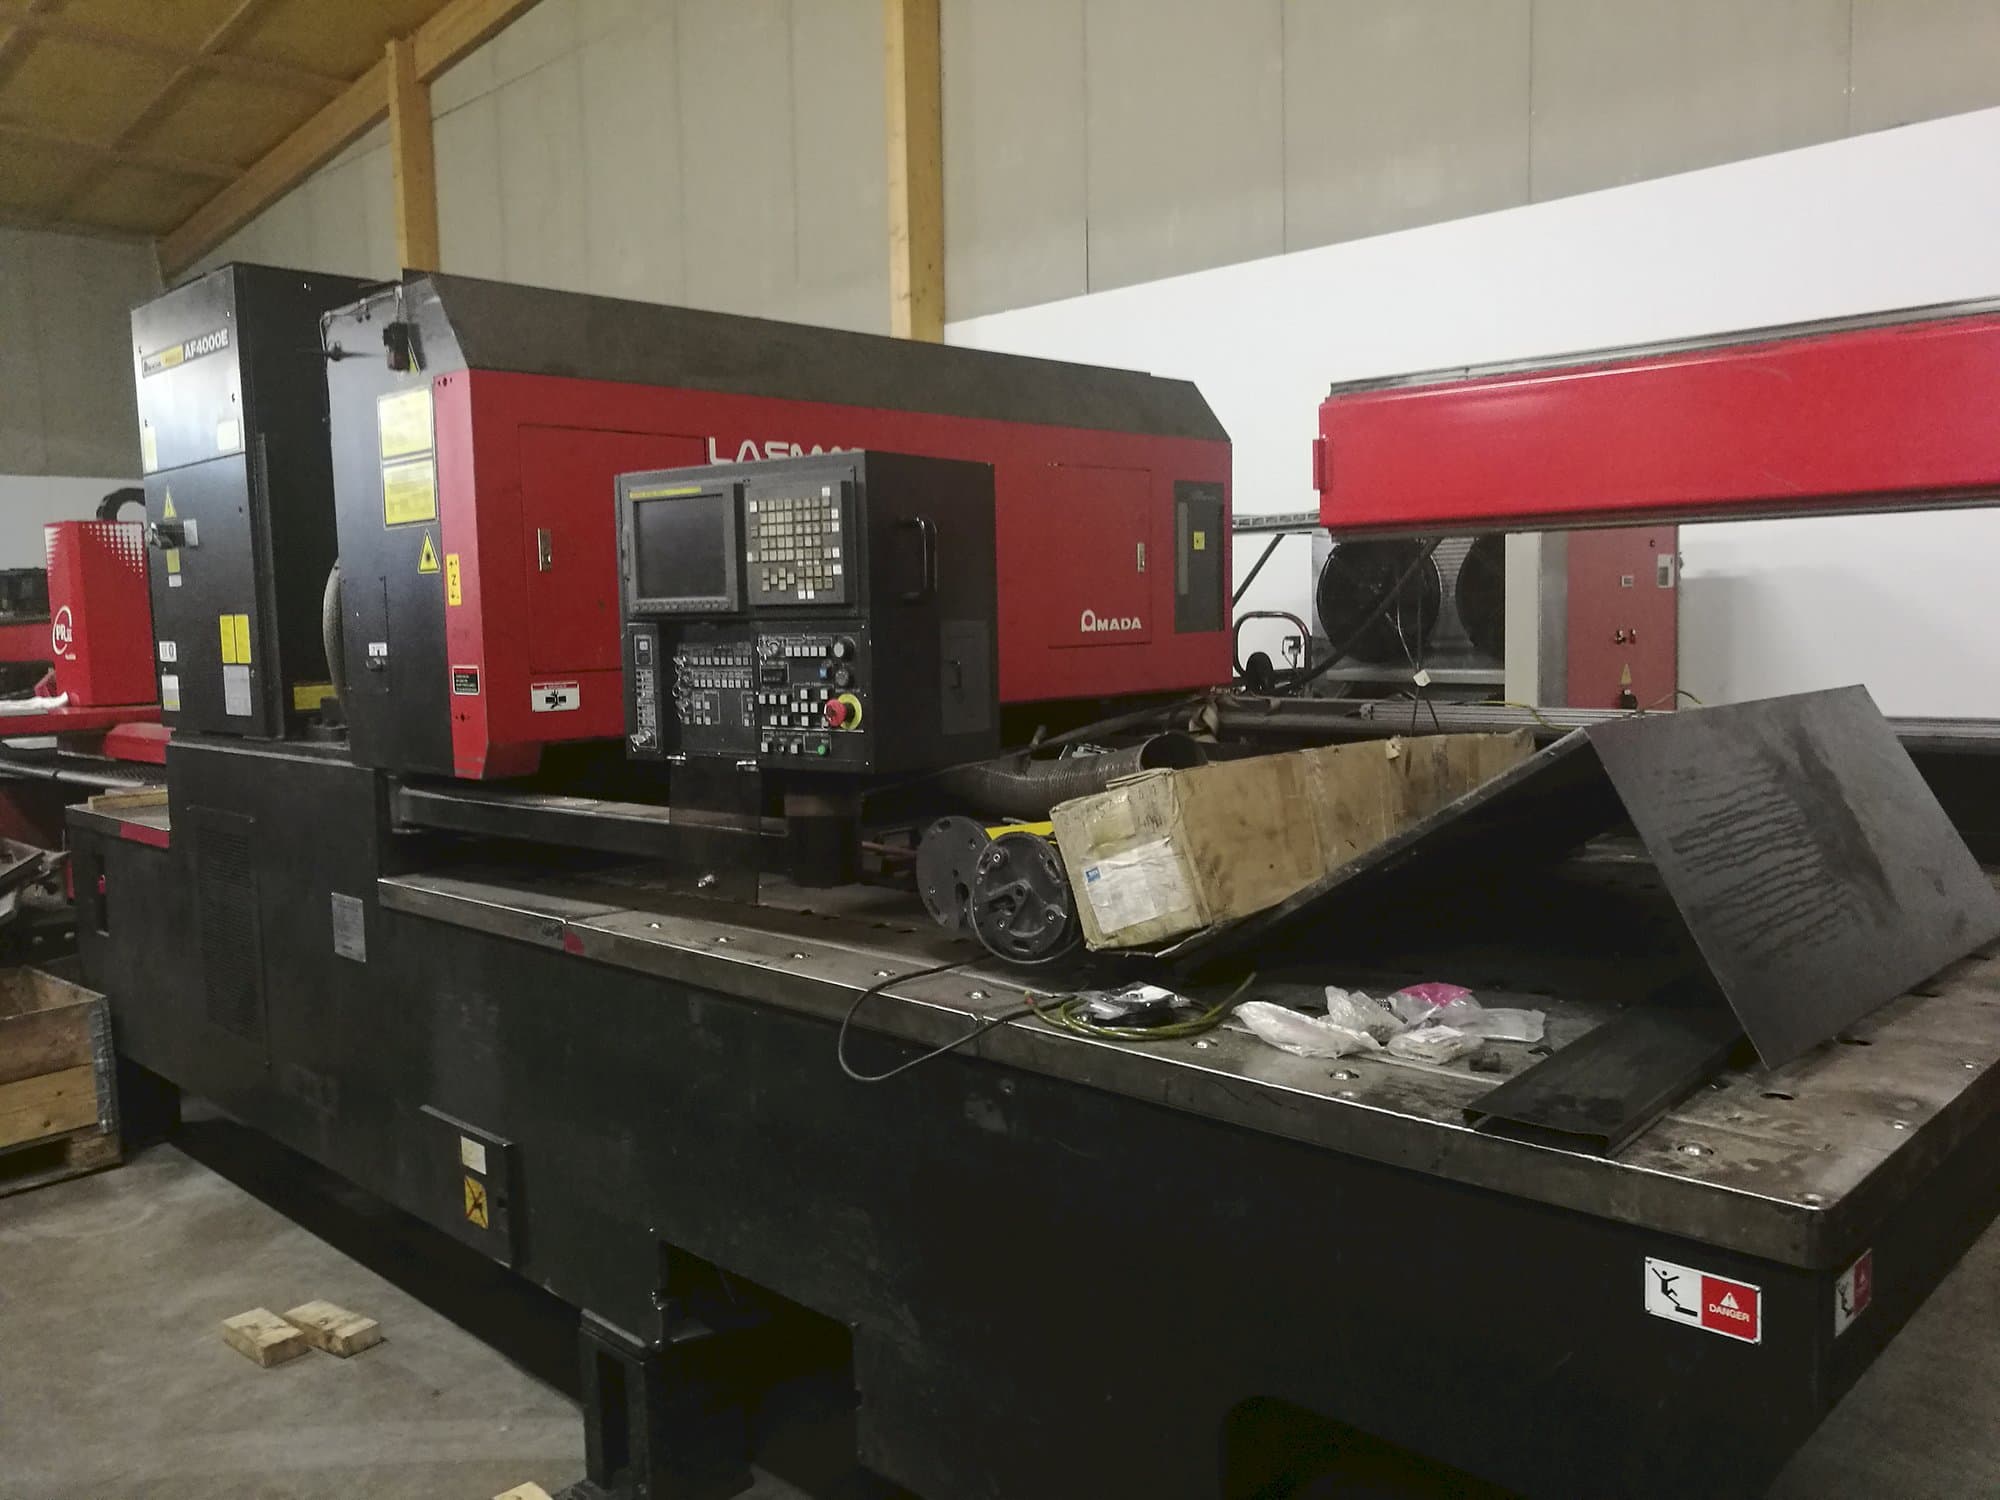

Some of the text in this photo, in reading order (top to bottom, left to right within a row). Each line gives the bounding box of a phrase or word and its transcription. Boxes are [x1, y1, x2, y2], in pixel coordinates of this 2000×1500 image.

[185, 328, 229, 361] AF4000E
[1081, 609, 1142, 632] AMADA
[1709, 1303, 1750, 1322] DANGER
